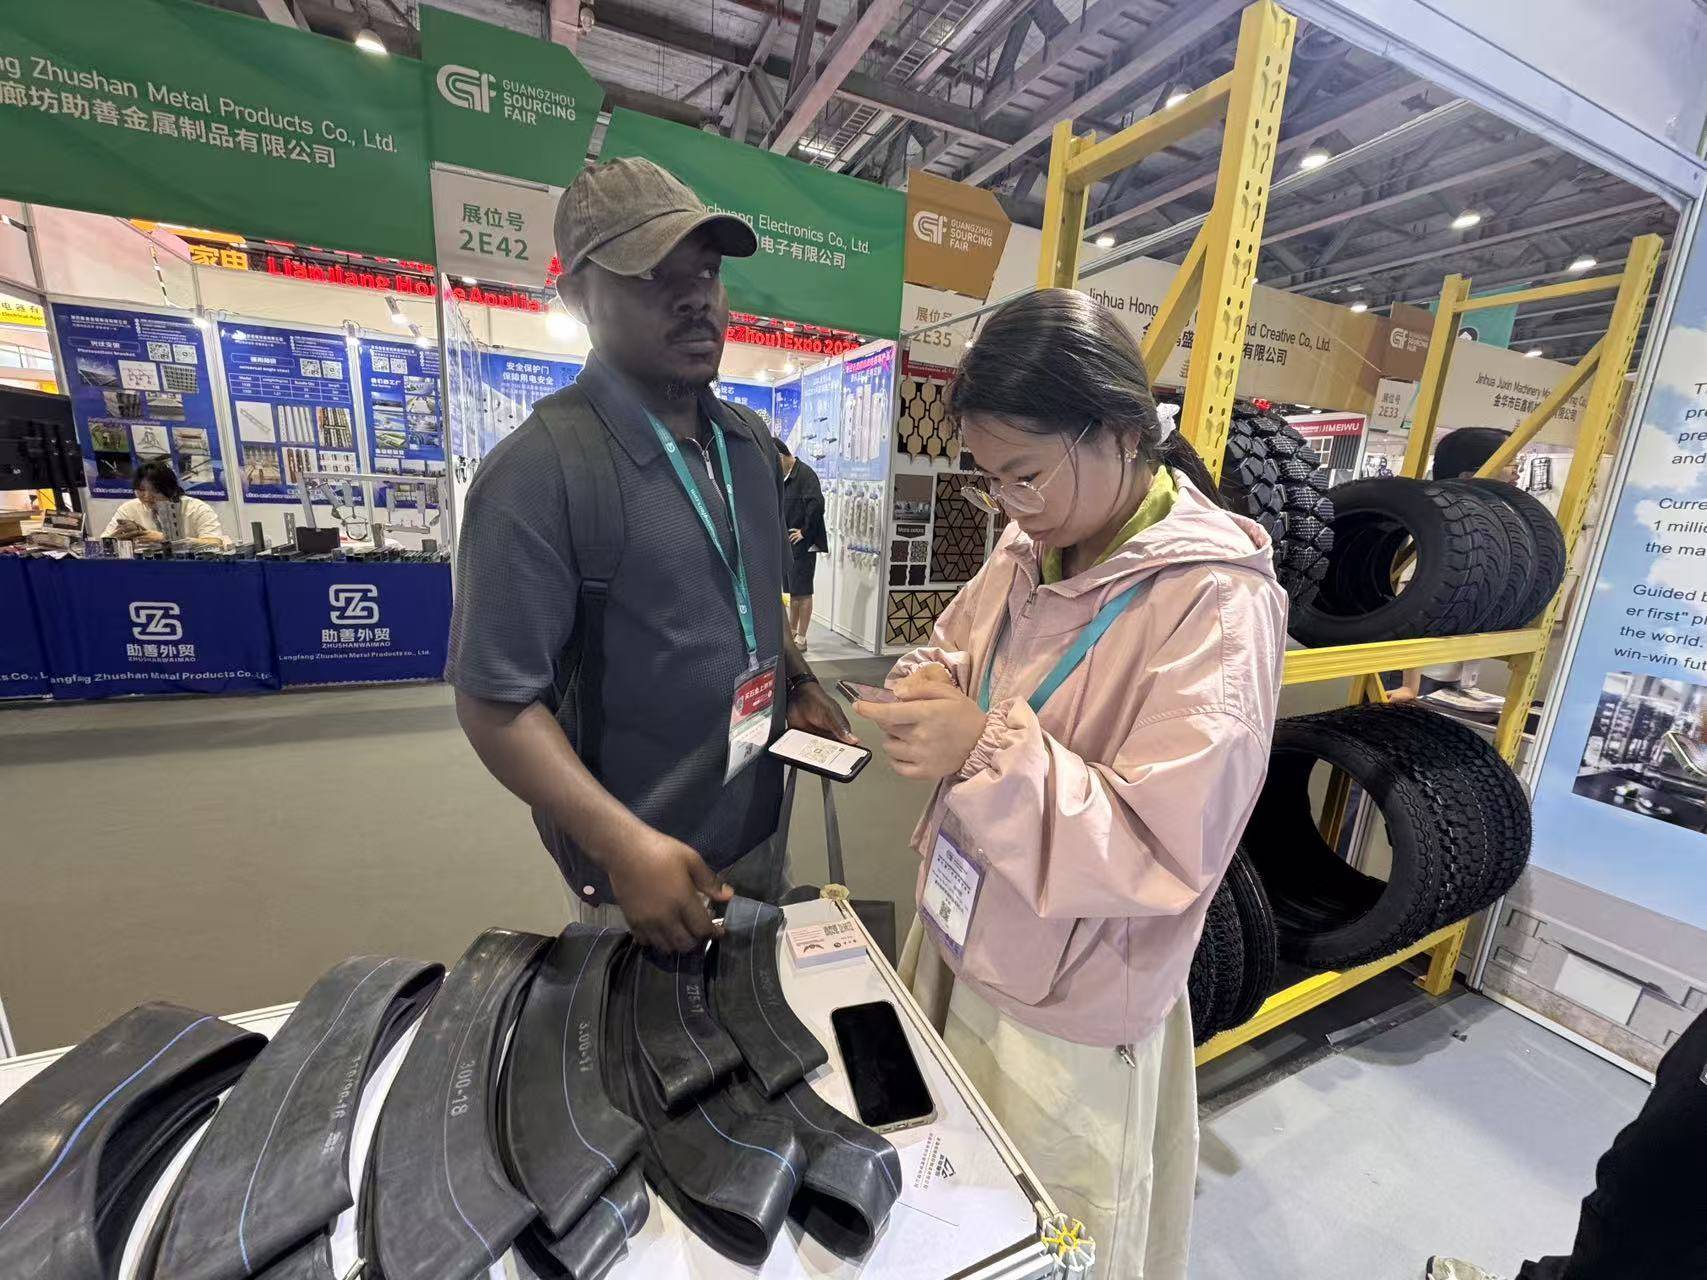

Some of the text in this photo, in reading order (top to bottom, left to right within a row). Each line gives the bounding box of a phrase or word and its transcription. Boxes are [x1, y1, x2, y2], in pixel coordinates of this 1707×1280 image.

[502, 78, 576, 107] GUANGZHOU
[30, 56, 138, 99] Zhushan
[147, 81, 210, 114] Metal
[219, 97, 313, 135] Products
[321, 120, 357, 148] Co.,
[364, 127, 398, 153] Ltd.
[503, 91, 577, 122] SOURCING
[0, 80, 337, 169] 廊坊助善金属制品有限公司
[504, 106, 537, 126] FAIR
[462, 202, 525, 233] 展位号
[758, 214, 824, 241] Electronics
[828, 231, 848, 251] Co.,
[851, 237, 871, 255] Ltd.
[950, 219, 993, 237] GUANGZHOU
[459, 229, 529, 261] 2E42
[949, 240, 969, 252] FAIR
[950, 228, 993, 248] SOURCING
[756, 232, 846, 270] 电子有限公司
[783, 333, 822, 353] Expo
[1259, 323, 1296, 345] Creative
[1316, 335, 1331, 353] Ltd.
[1242, 341, 1288, 366] 有限公司
[1694, 382, 1707, 395] T
[1378, 405, 1399, 419] 2E33
[1671, 452, 1707, 465] and
[1653, 520, 1661, 531] 1
[1645, 542, 1706, 557] the ma
[1632, 584, 1697, 602] Guided
[1626, 606, 1645, 616] er
[1647, 607, 1689, 623] first"
[321, 627, 391, 643] 助善外贸
[1619, 625, 1704, 648] the world.
[126, 643, 195, 658] 助善外贸
[321, 641, 391, 649] ZHUSHANWAIMAO
[278, 652, 315, 662] Langfang
[315, 651, 348, 660] Zhushan
[349, 650, 371, 658] Metal
[371, 649, 403, 658] Products
[1614, 647, 1678, 666] win-win
[94, 671, 149, 682] Zhushan
[150, 672, 181, 681] Metal
[181, 670, 235, 681] Products
[450, 1058, 476, 1118] 300-18
